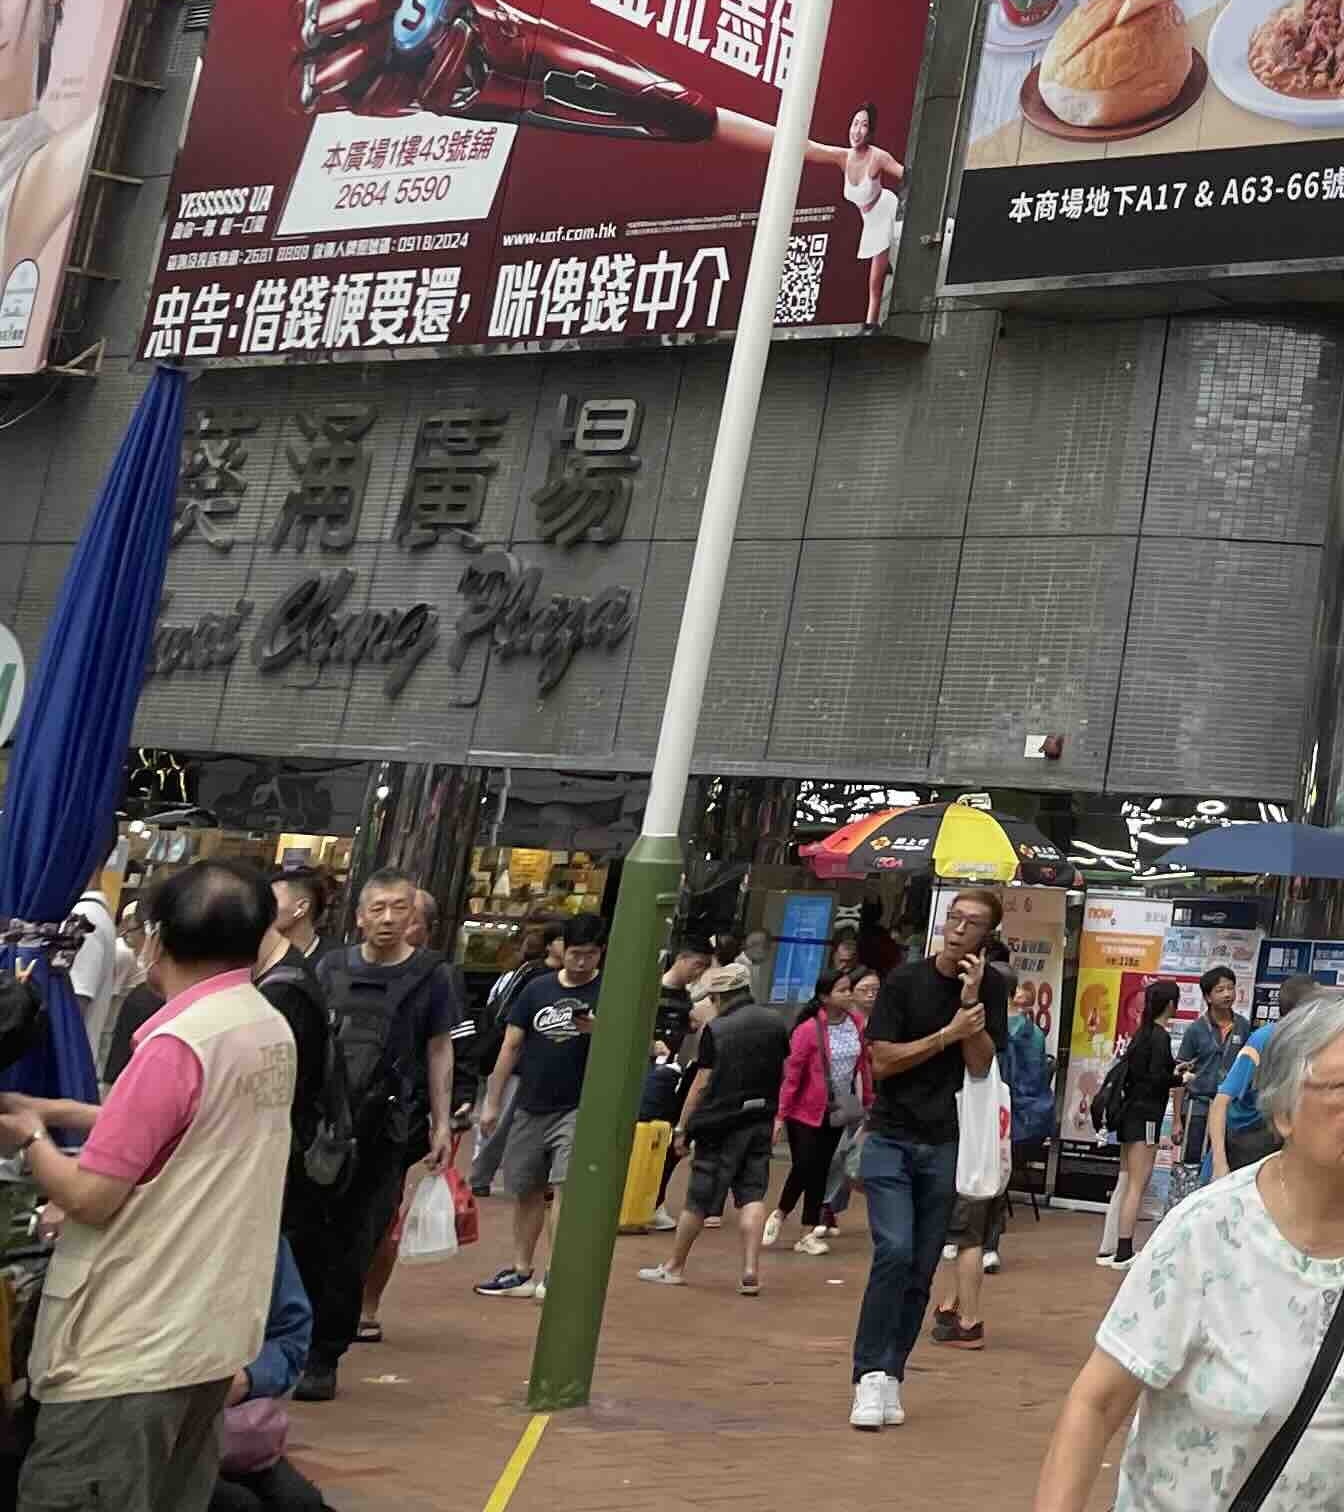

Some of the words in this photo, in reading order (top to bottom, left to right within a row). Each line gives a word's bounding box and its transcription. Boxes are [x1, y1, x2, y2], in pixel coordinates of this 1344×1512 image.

[335, 182, 389, 210] 2684
[394, 175, 452, 205] 5590
[1008, 178, 1188, 225] 本商場地下A17
[1194, 180, 1215, 208] &
